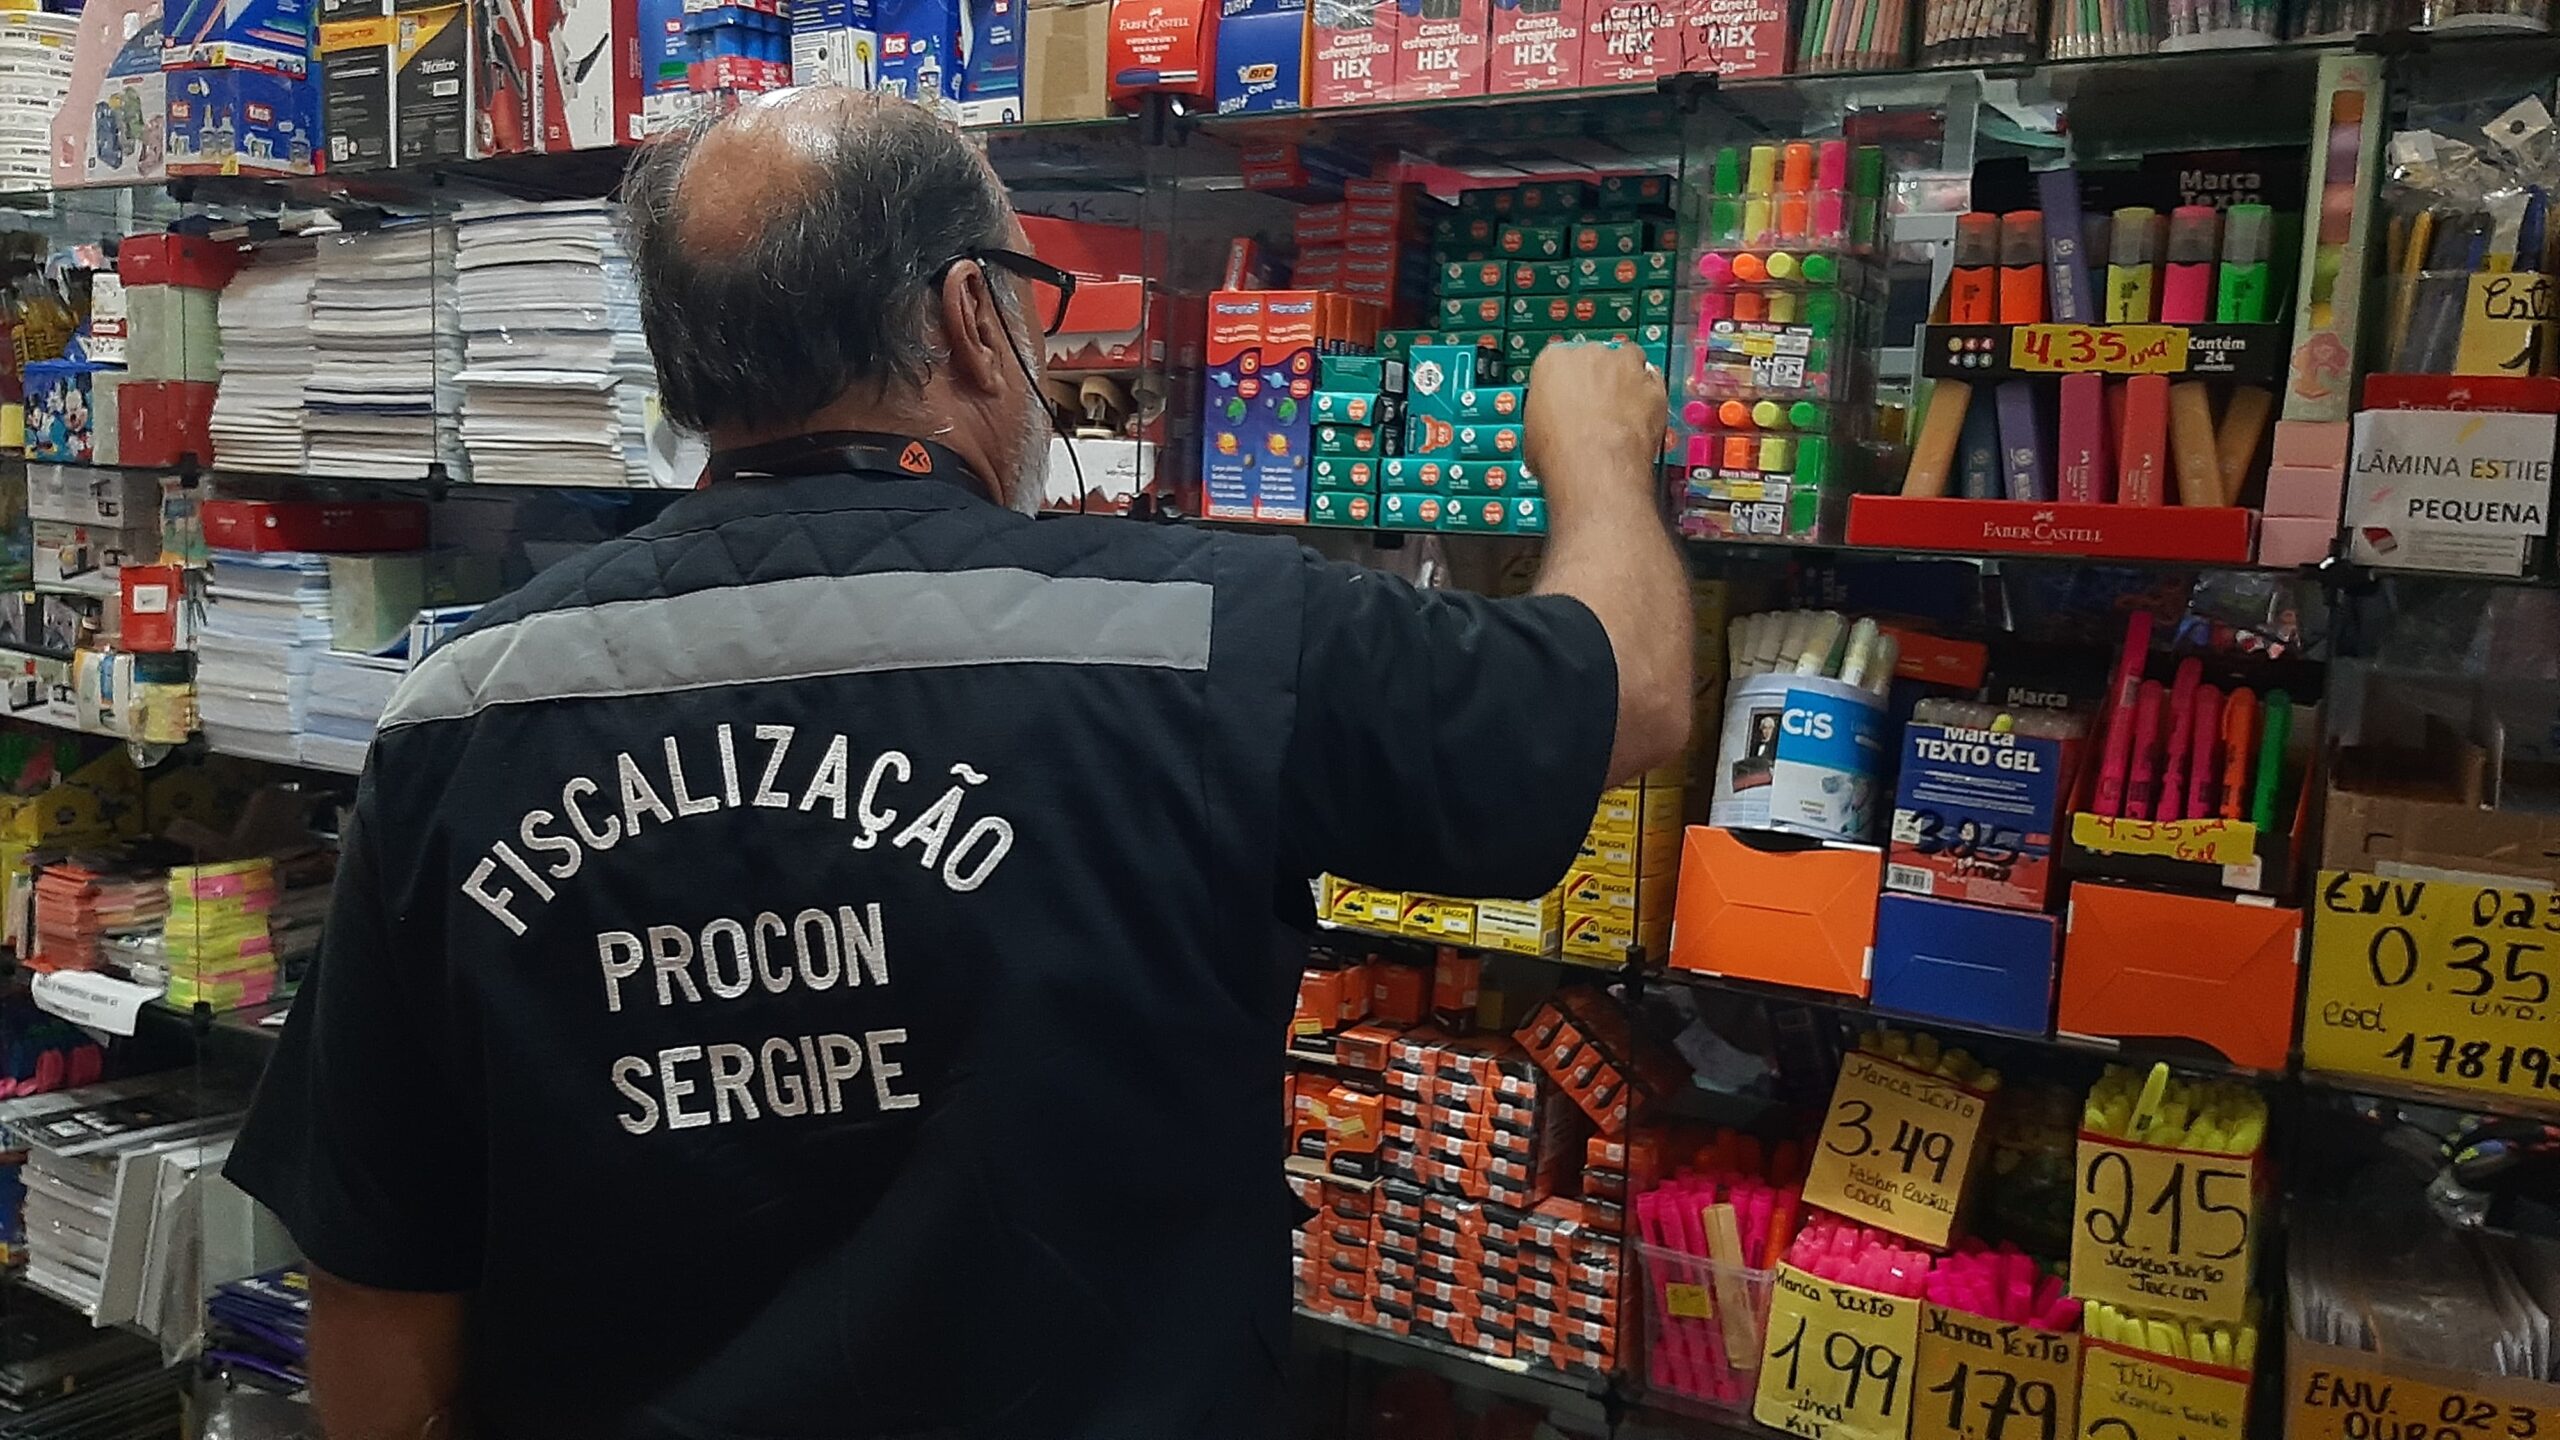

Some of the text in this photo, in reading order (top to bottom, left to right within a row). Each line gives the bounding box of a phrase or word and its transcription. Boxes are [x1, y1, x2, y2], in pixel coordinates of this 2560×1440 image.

[1711, 0, 1757, 12] Caneta
[1419, 23, 1460, 37] Caneta
[1515, 16, 1558, 31] Caneta
[1333, 33, 1373, 47] Caneta
[1708, 26, 1757, 49] HEX
[1417, 49, 1459, 71] HEX
[1514, 42, 1557, 66] HEX
[1248, 66, 1274, 79] BIC
[1332, 58, 1373, 81] HEX
[2179, 169, 2262, 190] Marca
[2023, 329, 2129, 370] 4.35
[2187, 336, 2247, 351] Contém
[1750, 355, 1773, 371] 6+
[2203, 351, 2226, 364] 24
[2356, 449, 2461, 477] LÂMINA
[1730, 501, 1754, 517] 6+
[2408, 498, 2541, 525] PEQUENA
[2007, 687, 2068, 708] Marca
[1943, 726, 2015, 748] Marca
[1915, 737, 2041, 774] TEXTO GEL
[461, 723, 1014, 937] FISCALIZAÇÃO
[2095, 815, 2183, 841] 4.35
[1601, 883, 1631, 894] BACCHI
[1440, 907, 1470, 919] BACCHI
[1601, 926, 1632, 937] BACCHI
[597, 902, 889, 1012] PROCON
[2368, 925, 2550, 1004] 0.35
[611, 1028, 920, 1135] SERGIPE
[1825, 1100, 1955, 1184] 3.49
[2084, 1151, 2248, 1260] 2.15
[1928, 1361, 2058, 1440] 1.79
[2304, 1371, 2539, 1439] ENV. 023
